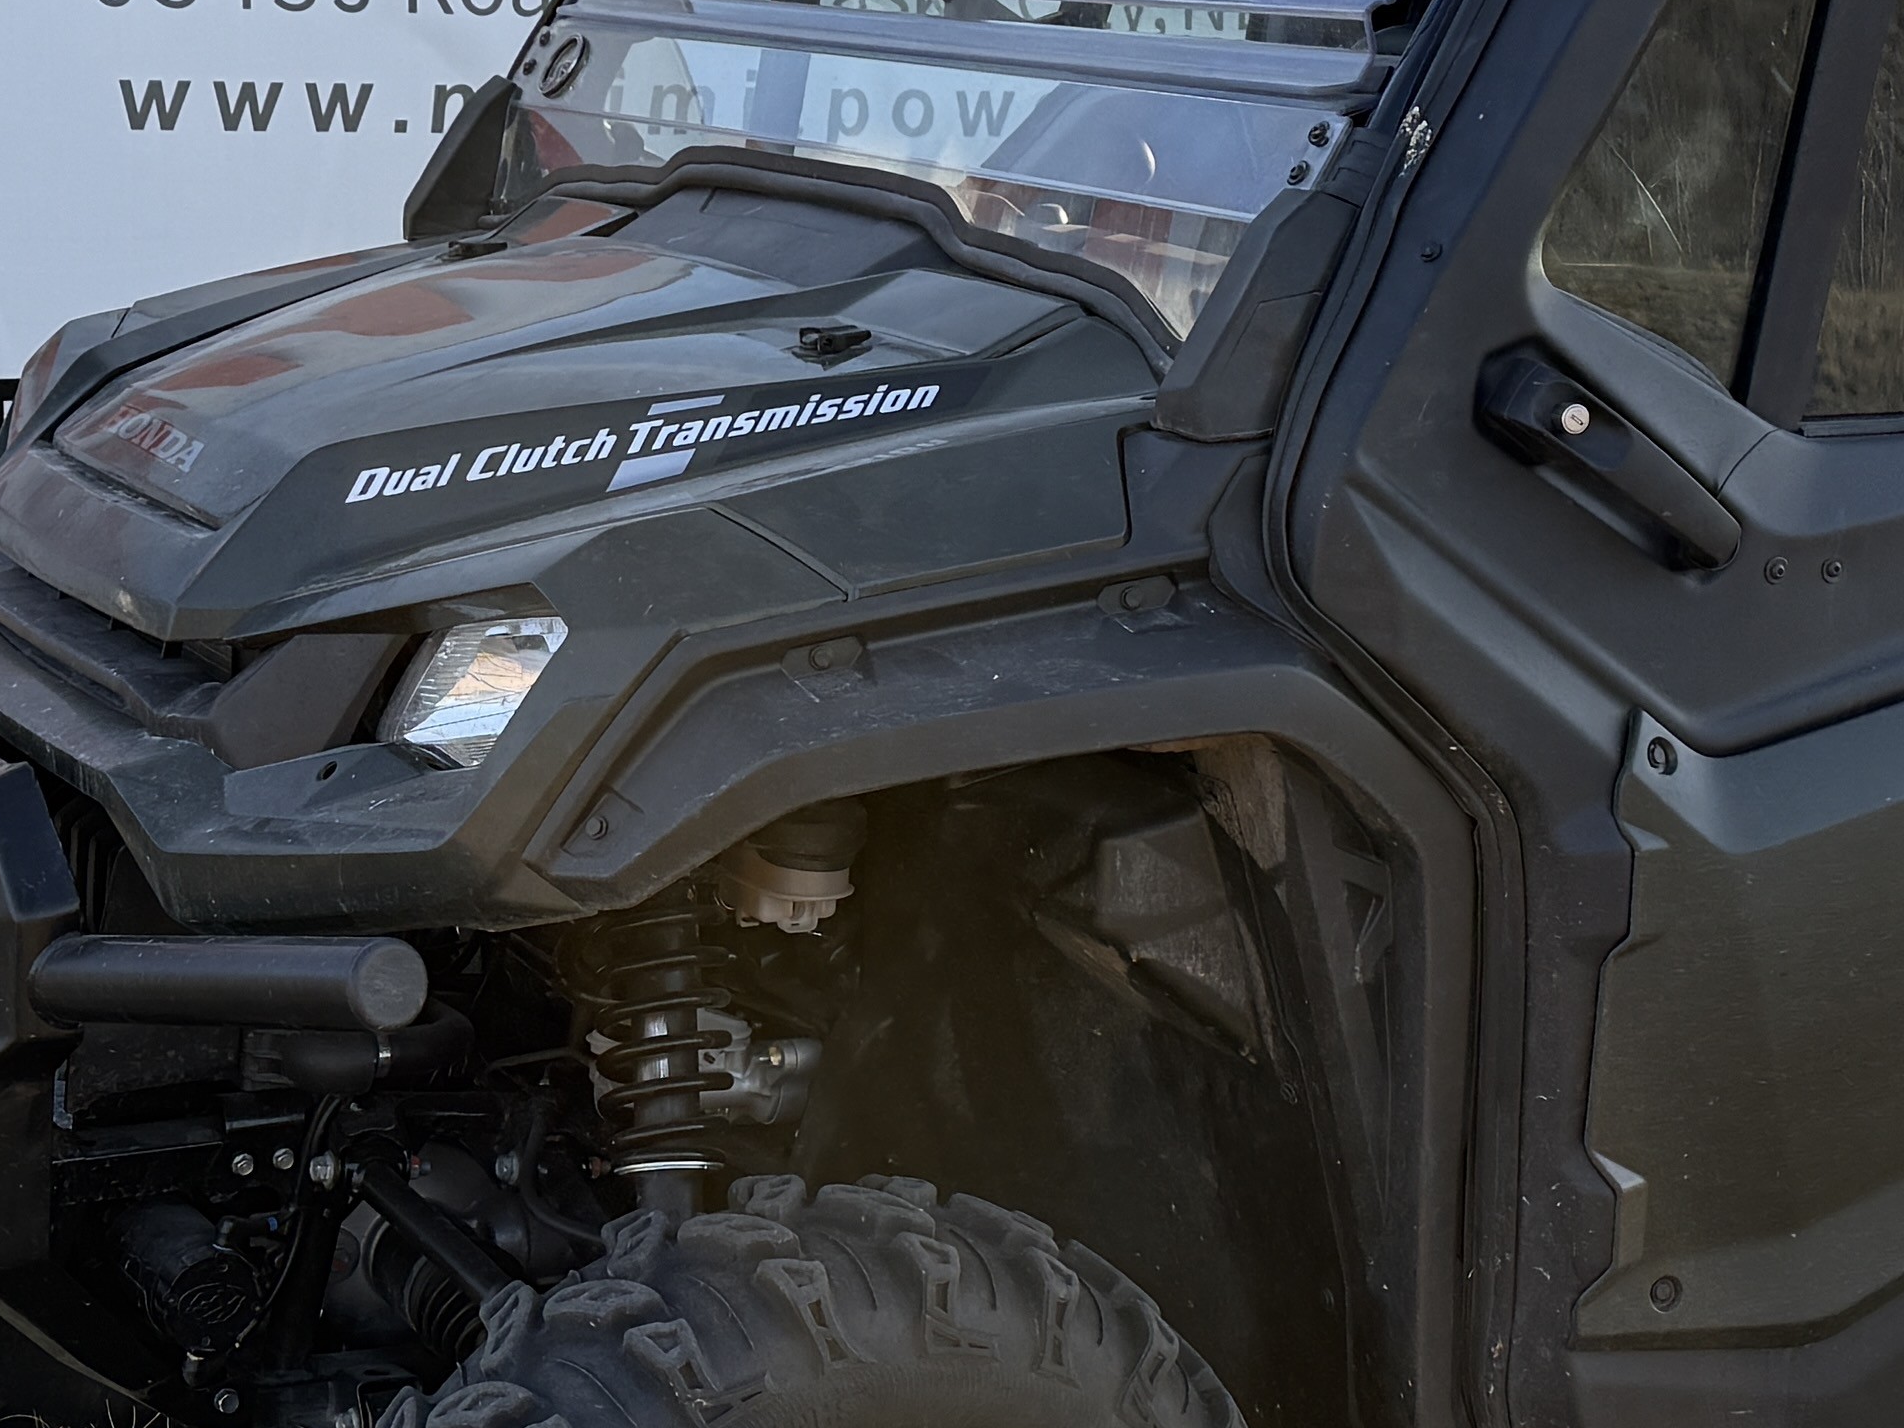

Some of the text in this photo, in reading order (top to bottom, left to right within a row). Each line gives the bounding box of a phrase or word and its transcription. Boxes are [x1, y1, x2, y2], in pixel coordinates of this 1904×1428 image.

[344, 382, 941, 504] Dual Clutch Transmission
